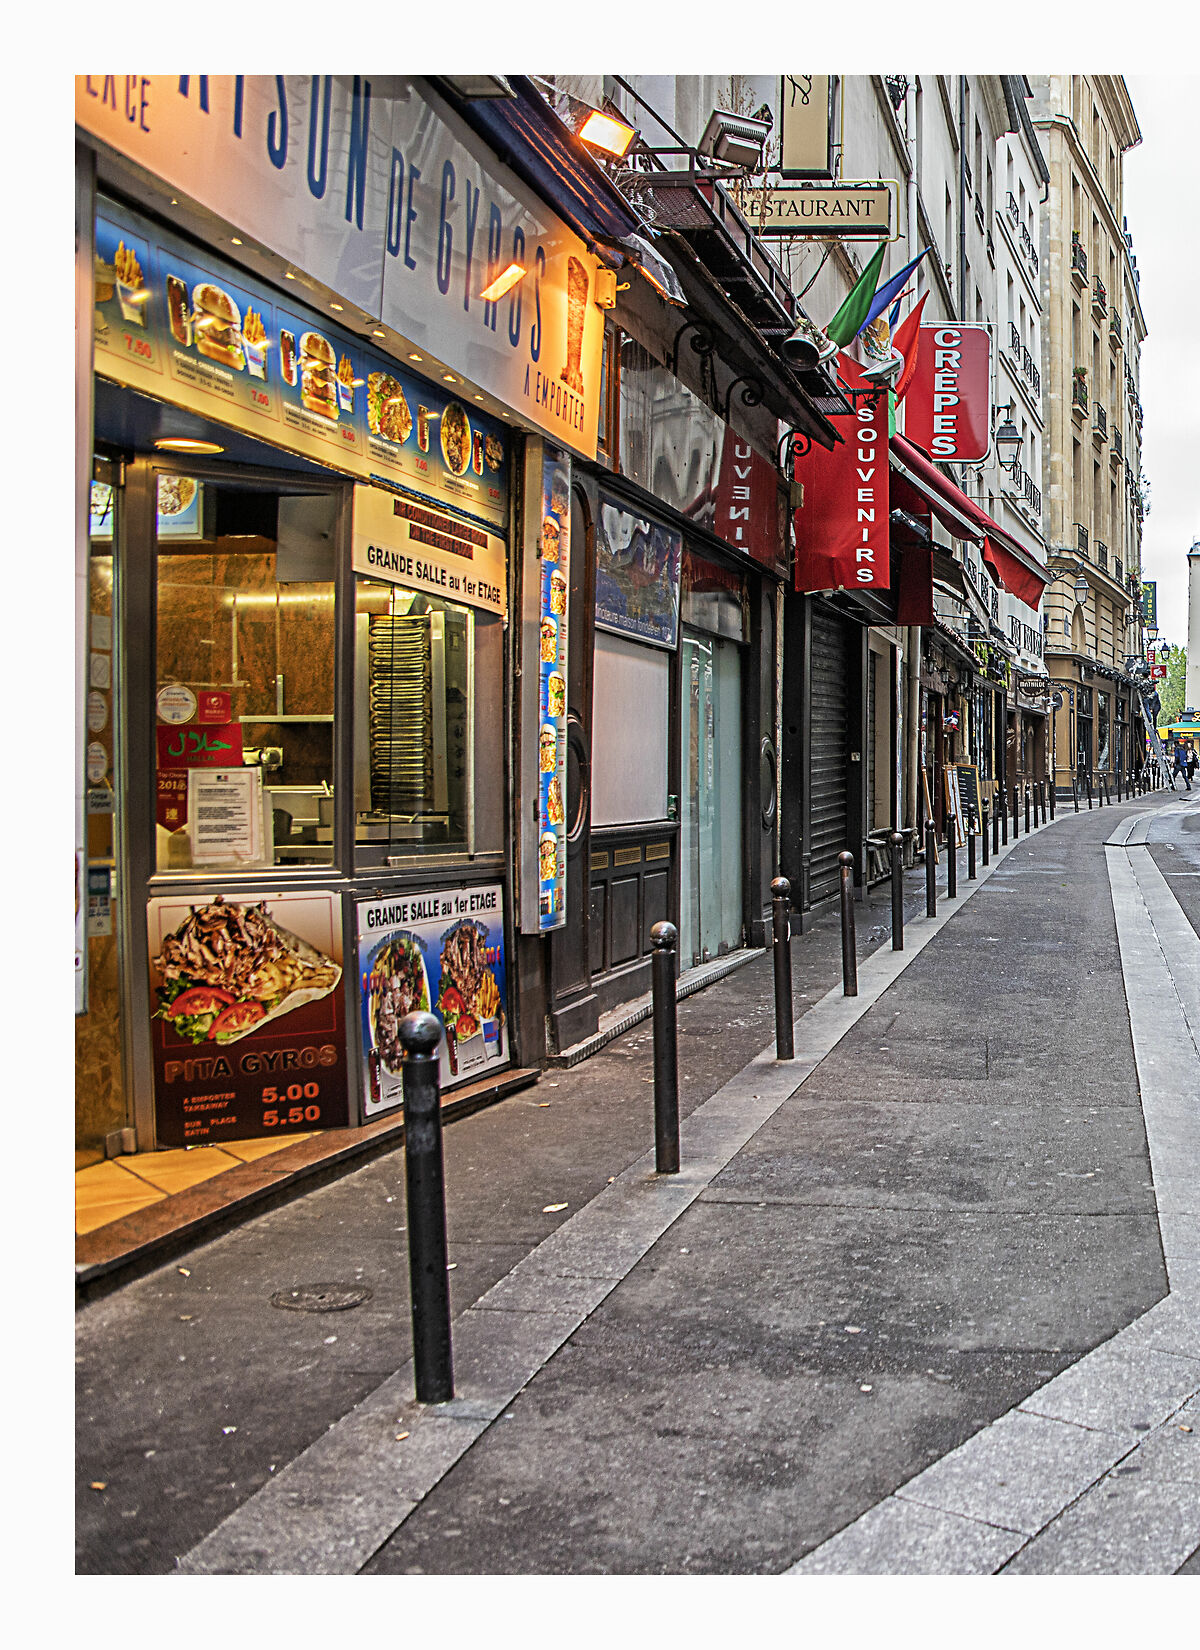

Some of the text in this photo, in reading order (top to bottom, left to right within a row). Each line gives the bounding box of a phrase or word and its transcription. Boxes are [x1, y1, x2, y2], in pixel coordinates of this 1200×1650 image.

[741, 199, 876, 217] RESTAURANT
[387, 146, 421, 271] DE
[436, 159, 546, 363] GYROS
[524, 363, 586, 433] A EMPORTER
[930, 329, 963, 456] CRÊPES
[856, 408, 878, 583] SOUVENIRS
[367, 545, 501, 605] GRANDE SALLE au 1er ETAGE
[168, 731, 232, 757] حلال
[367, 892, 497, 929] GRANDE SALLE au 1er ETAGE
[164, 1044, 338, 1084] PITA GYROS
[261, 1082, 320, 1104] 5.00
[263, 1105, 321, 1127] 5.50
